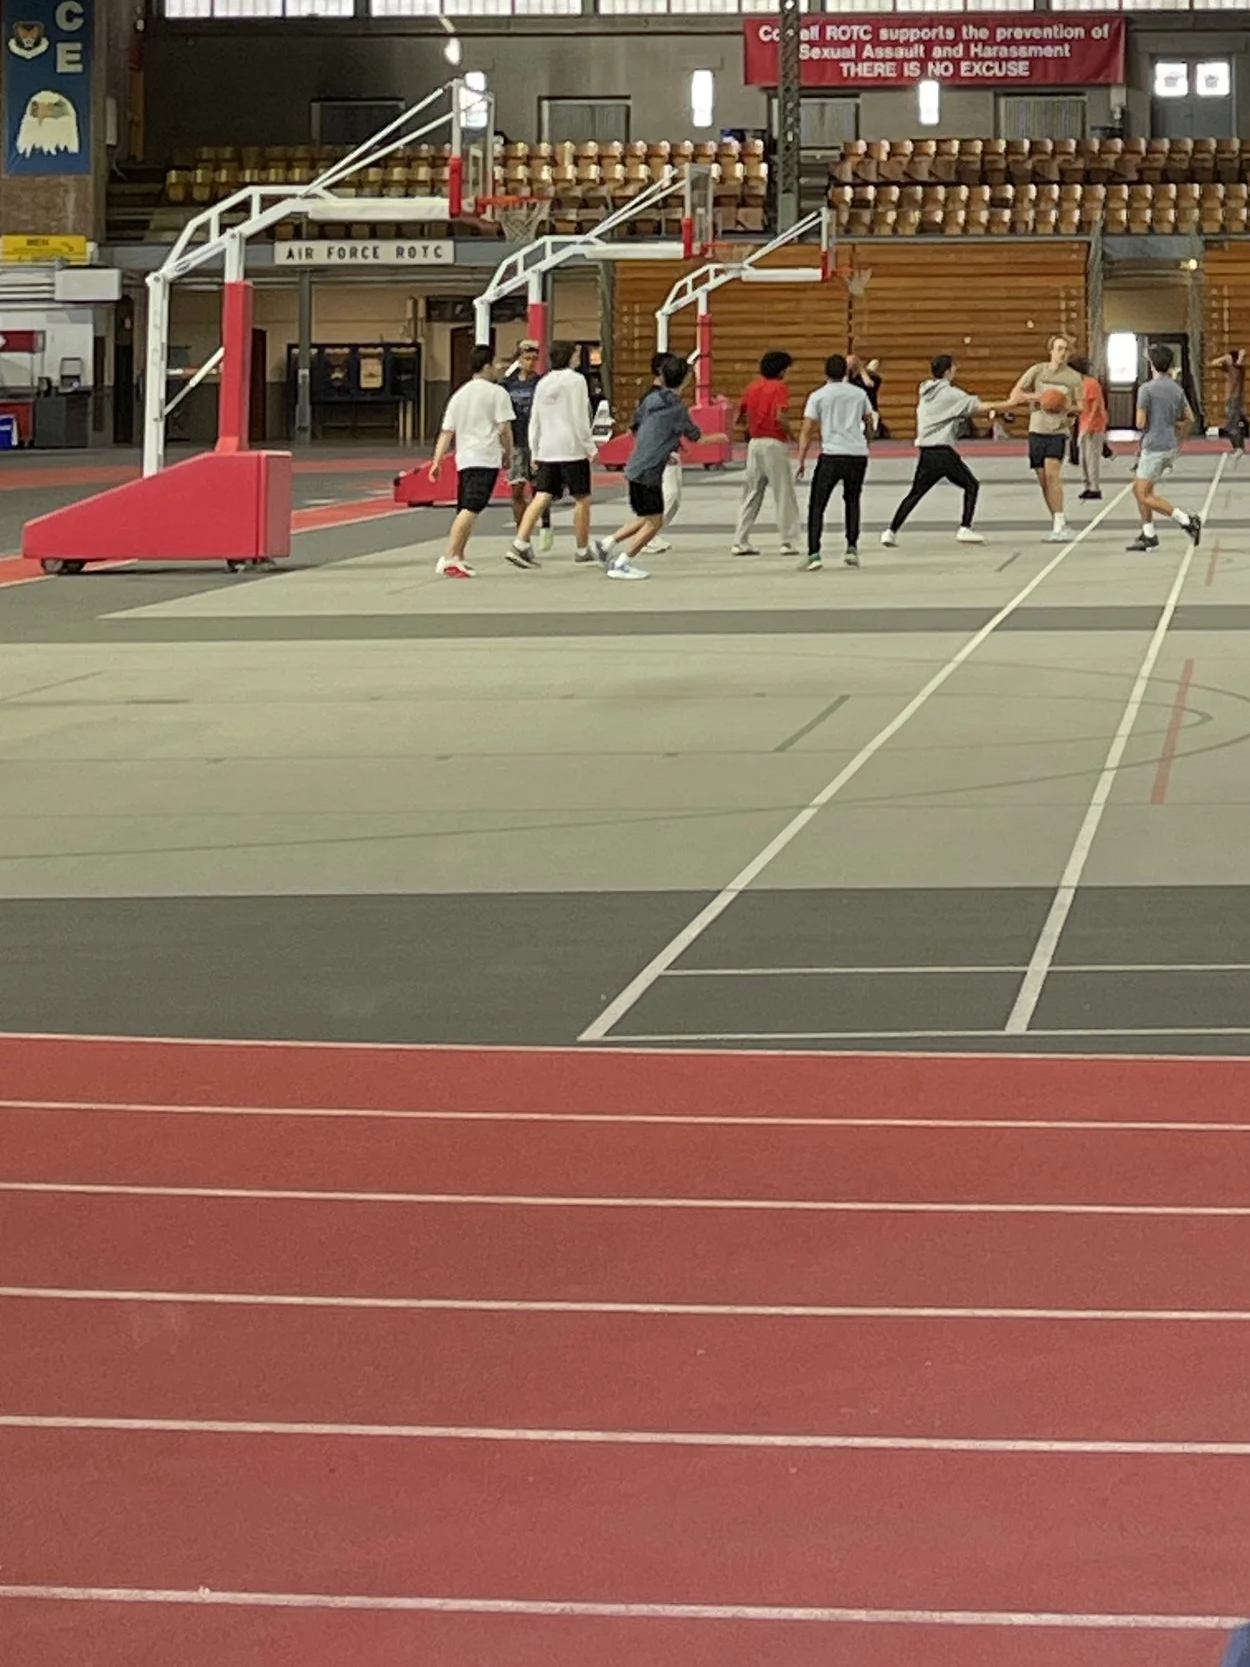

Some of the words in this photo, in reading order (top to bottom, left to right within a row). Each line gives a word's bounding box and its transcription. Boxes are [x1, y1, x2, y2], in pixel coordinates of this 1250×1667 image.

[758, 24, 820, 42] Coell
[825, 24, 873, 41] ROTC
[878, 24, 955, 43] supports
[961, 24, 990, 40] the
[995, 23, 1086, 42] prevention
[1091, 23, 1110, 39] of
[798, 44, 857, 60] Sexual
[861, 43, 925, 59] Assault
[931, 43, 964, 58] and
[970, 42, 1072, 58] Harassment
[839, 61, 897, 78] THERE
[903, 61, 921, 77] IS
[928, 61, 954, 77] NO
[960, 60, 1030, 77] EXCUSE
[286, 245, 315, 260] AIR
[326, 245, 381, 260] FORCE
[395, 245, 443, 259] ROTC
